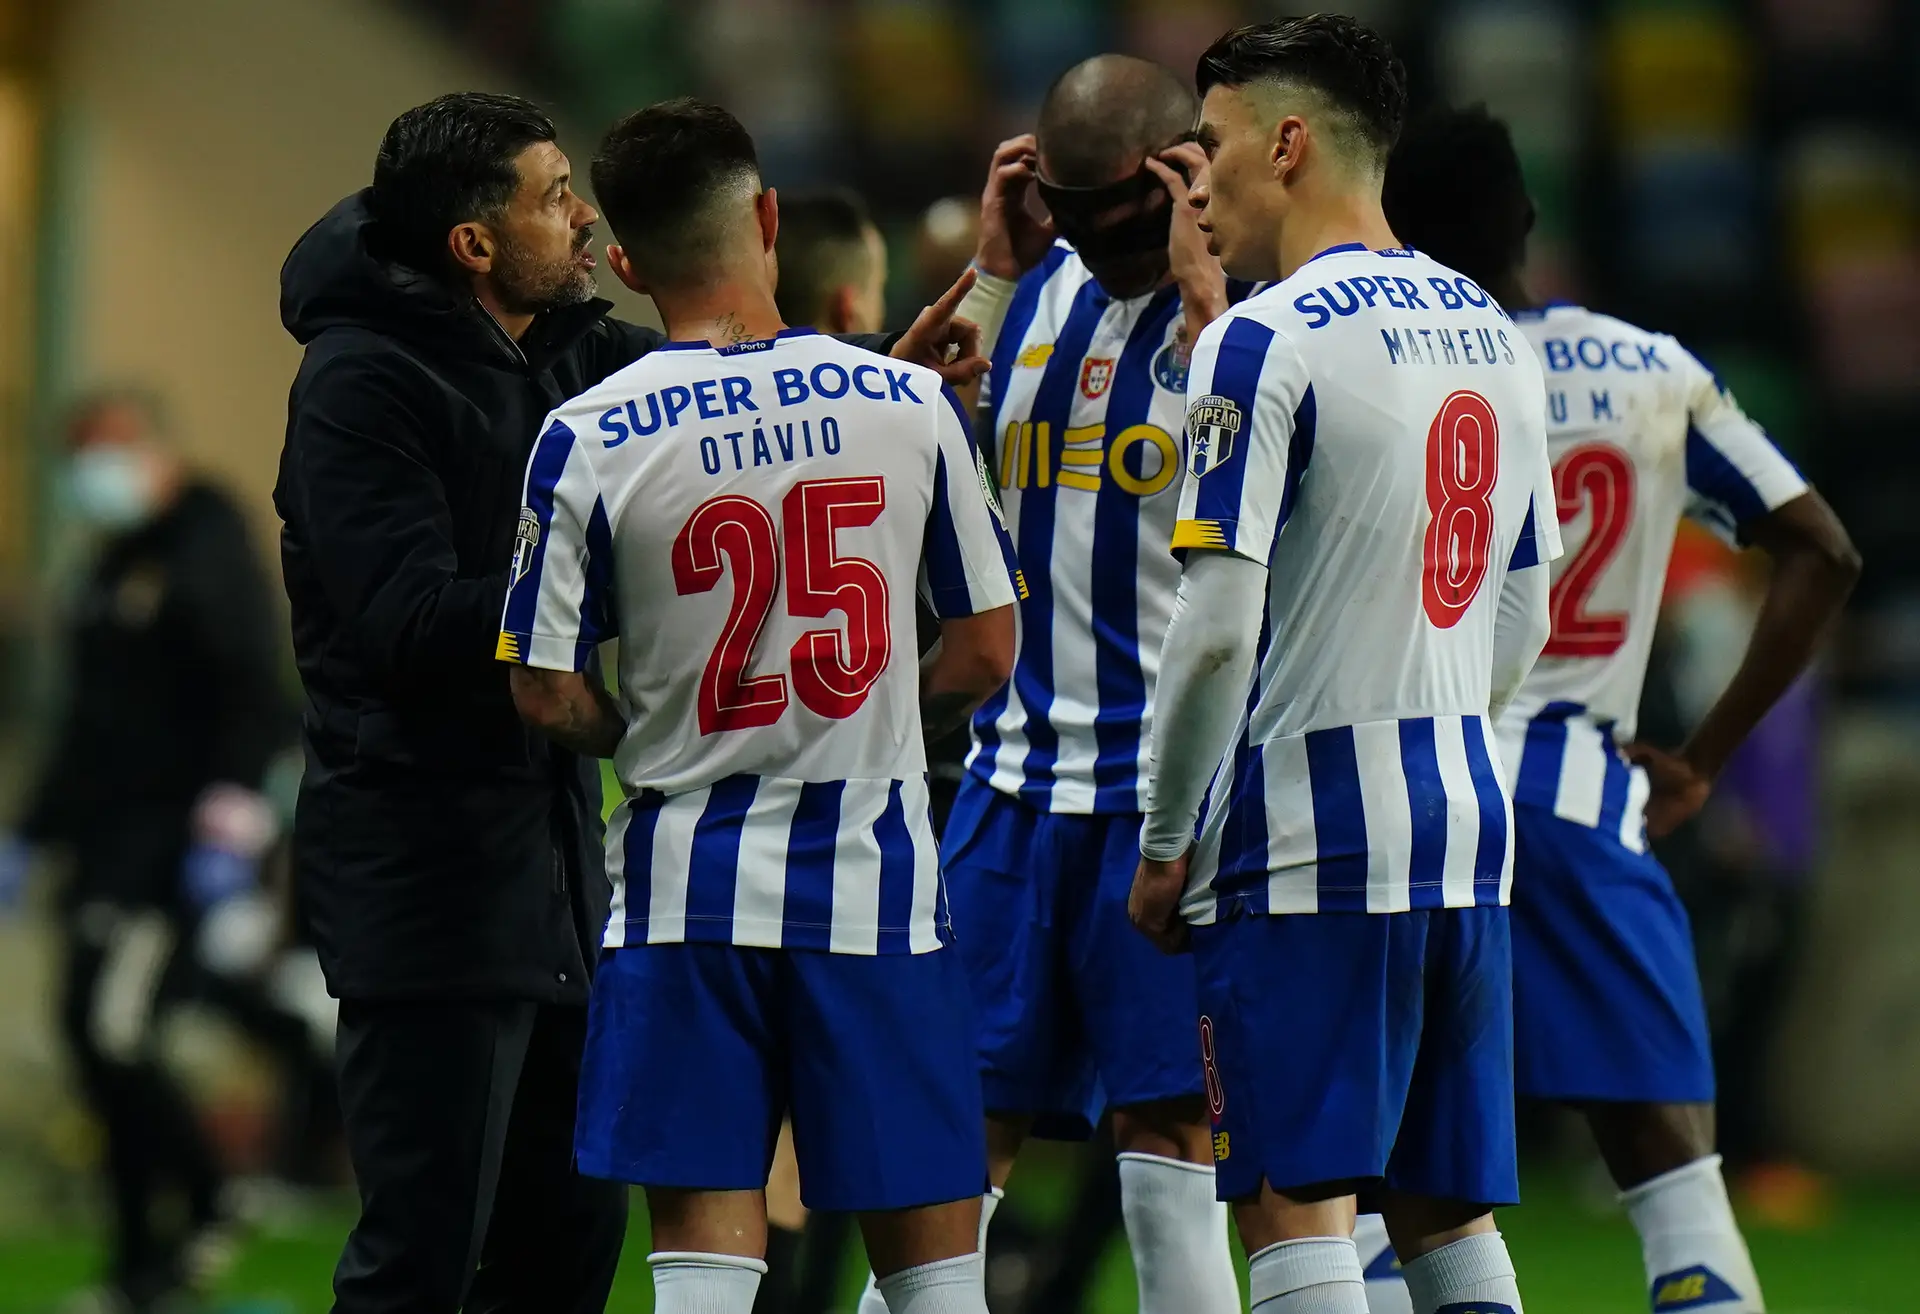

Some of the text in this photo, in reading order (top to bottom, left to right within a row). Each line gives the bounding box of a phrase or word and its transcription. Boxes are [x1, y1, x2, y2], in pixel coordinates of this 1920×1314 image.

[1293, 275, 1429, 329] SUPER
[740, 342, 766, 351] Porto
[1380, 327, 1516, 365] MATHEUS
[1544, 336, 1670, 372] BOCK
[598, 362, 924, 449] SUPER BOCK
[700, 416, 841, 475] OTÁVIO
[1421, 389, 1499, 629] 8
[1541, 440, 1638, 656] 2
[671, 476, 891, 736] 25
[1200, 1014, 1224, 1125] 8
